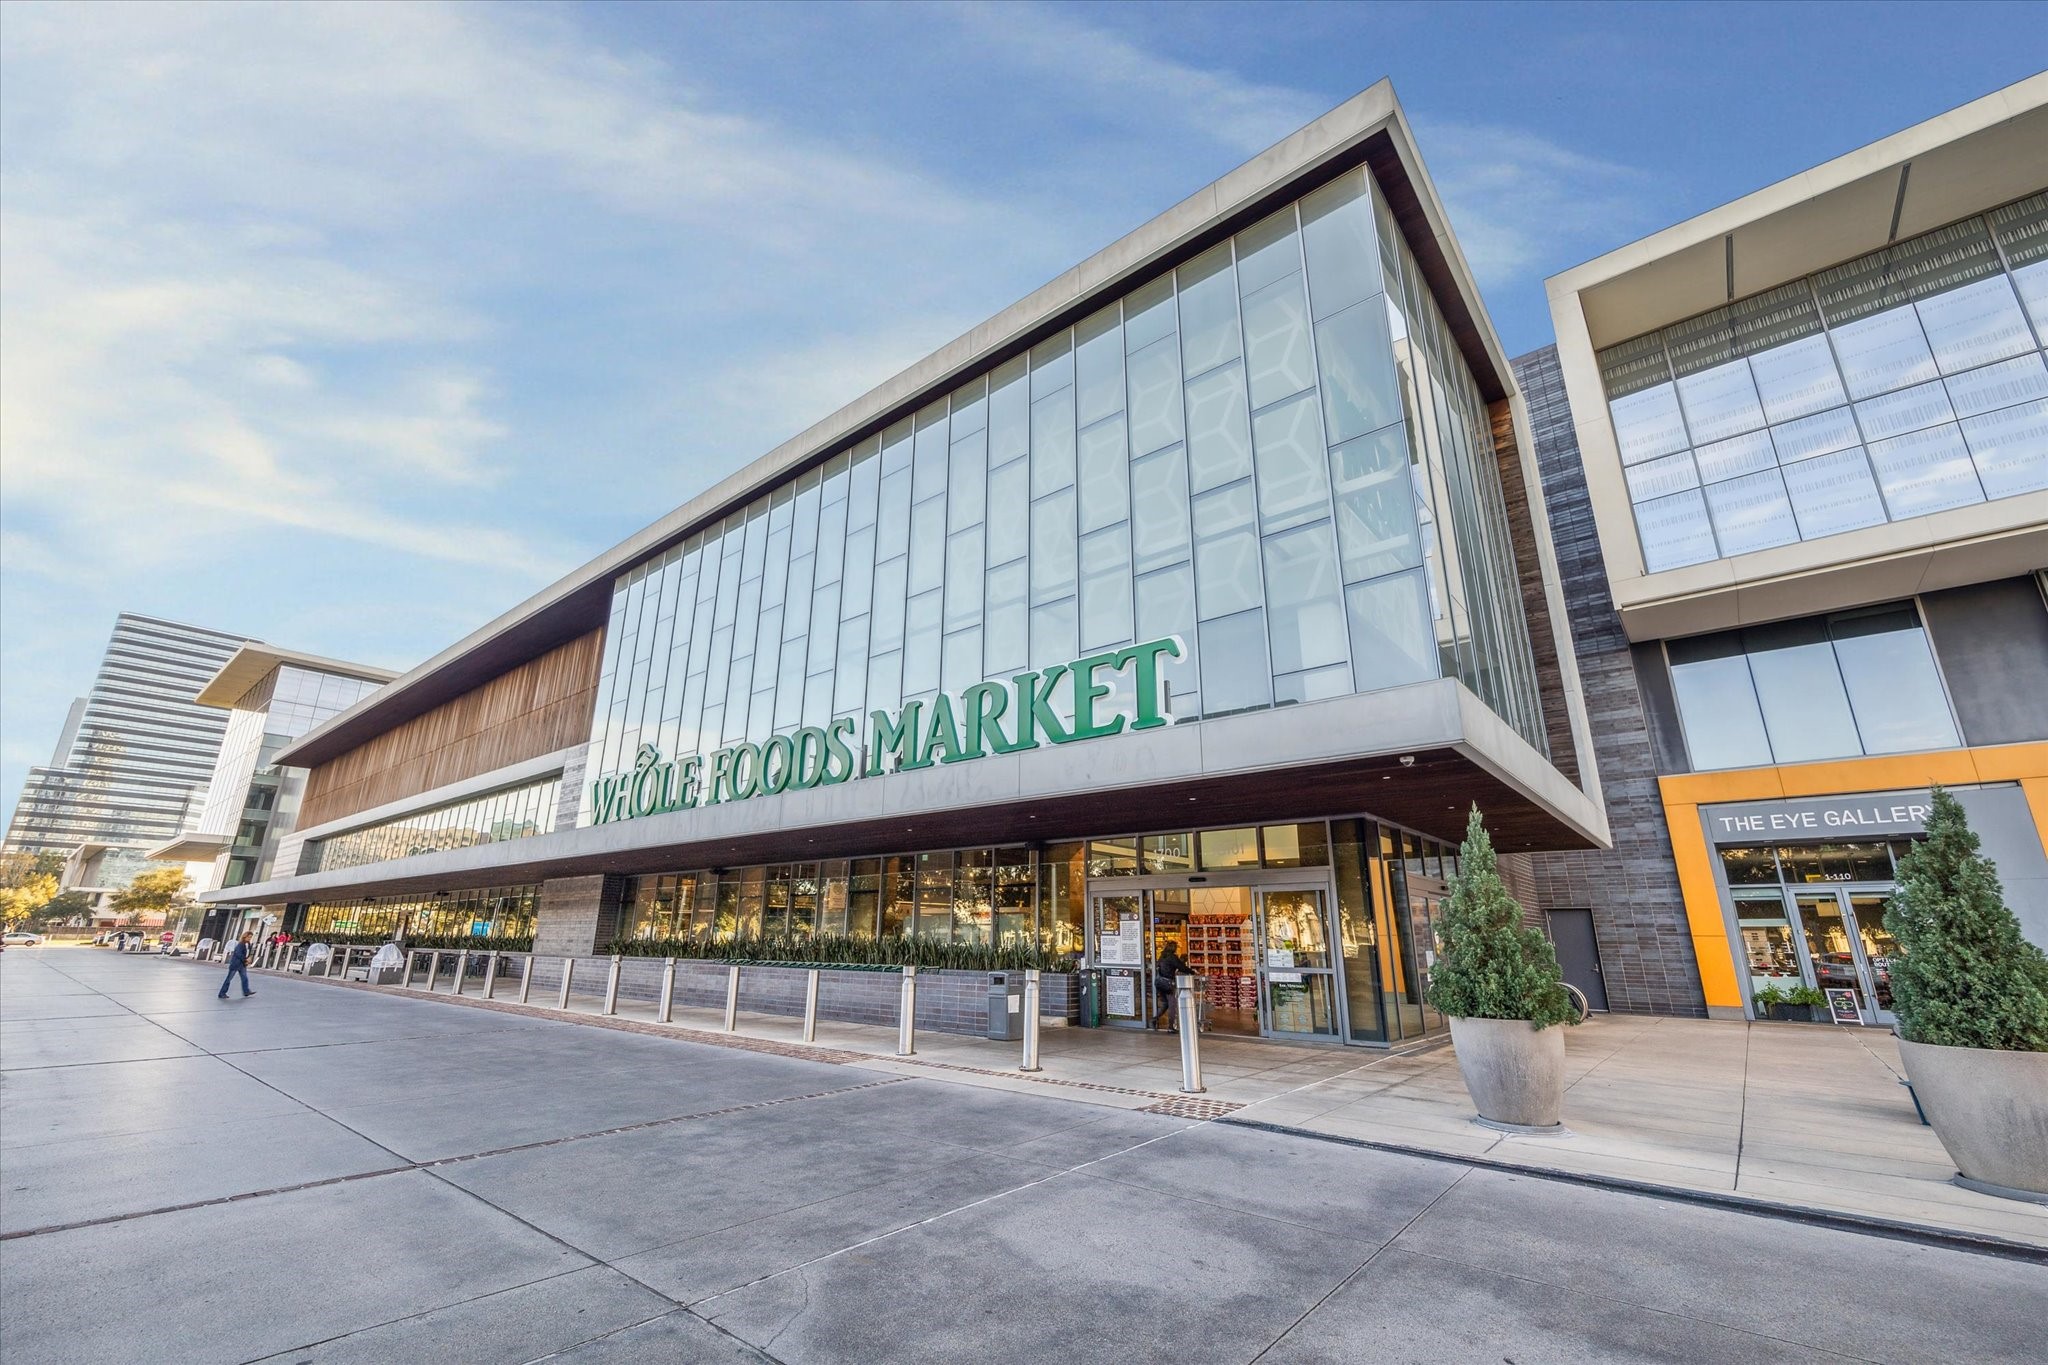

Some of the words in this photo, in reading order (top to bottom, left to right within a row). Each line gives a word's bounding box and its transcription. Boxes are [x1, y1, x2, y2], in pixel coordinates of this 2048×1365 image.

[589, 743, 702, 825] WHOLE
[705, 717, 855, 806] FOODS
[865, 638, 1182, 776] MARKET
[1719, 815, 1765, 832] THE
[1771, 812, 1818, 829] EYE
[1824, 872, 1852, 881] 1-110
